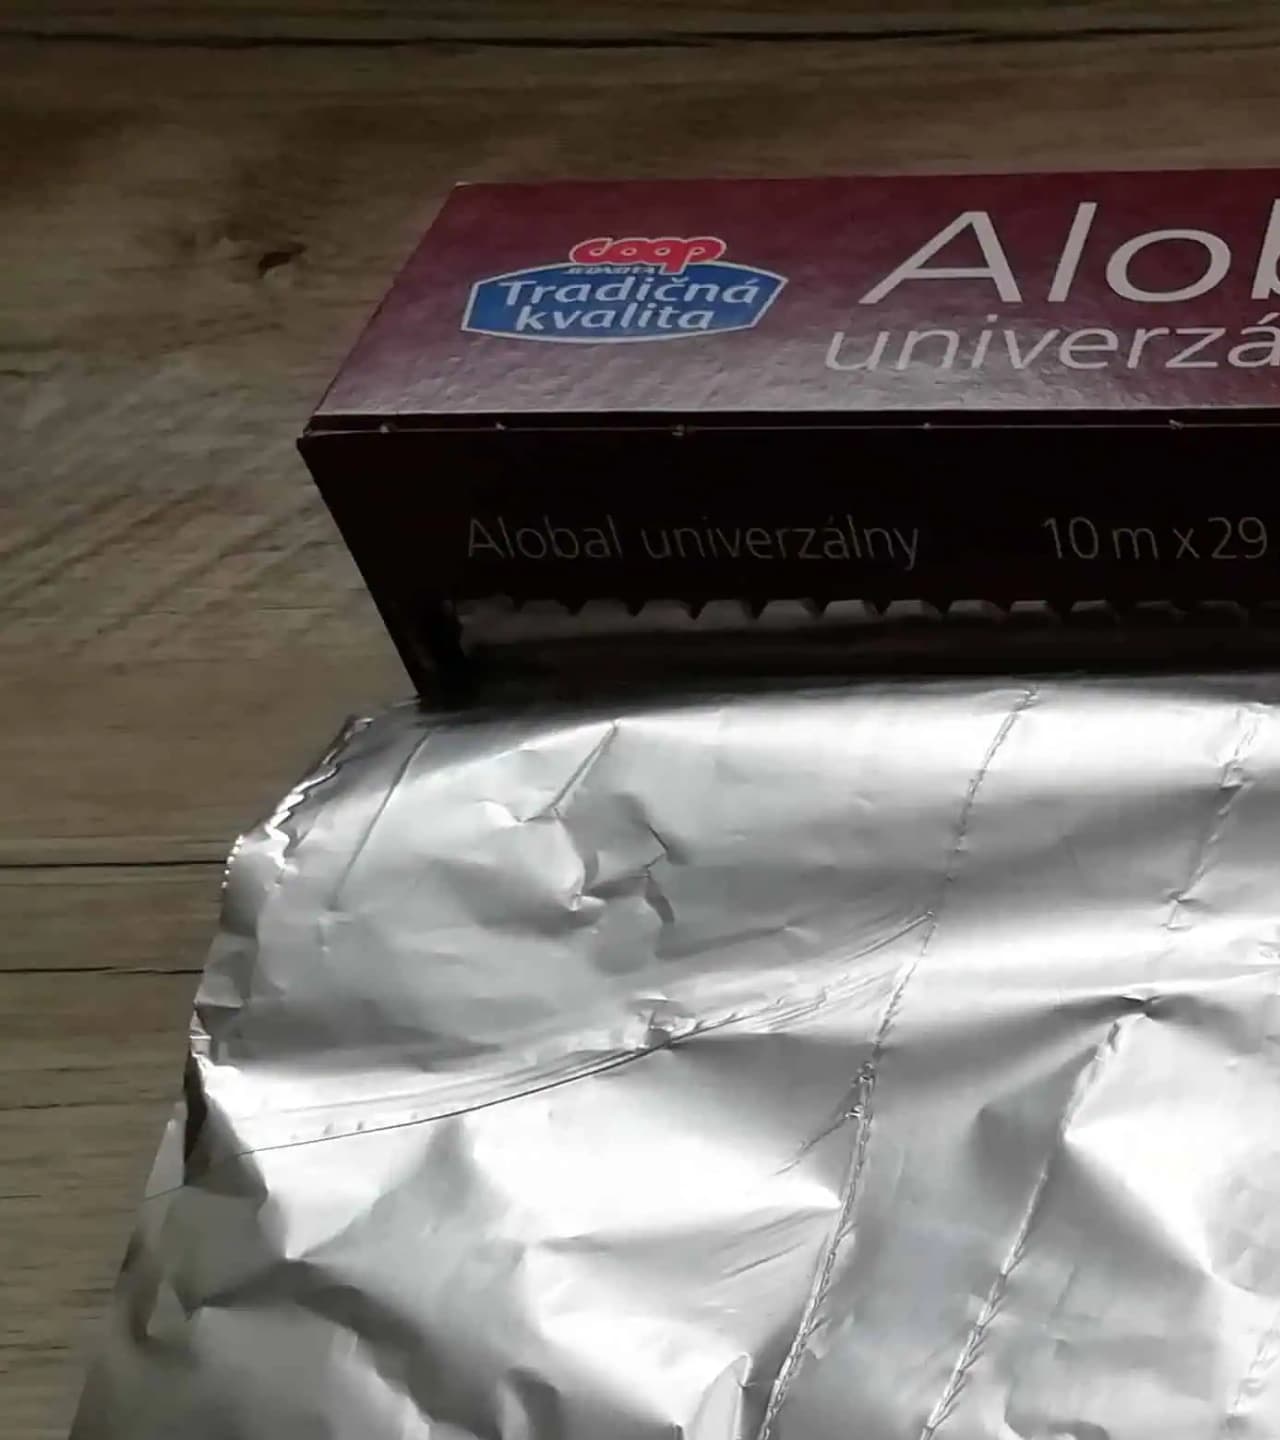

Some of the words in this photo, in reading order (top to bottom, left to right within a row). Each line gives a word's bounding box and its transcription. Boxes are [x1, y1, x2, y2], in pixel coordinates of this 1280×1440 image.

[499, 275, 761, 307] Tradičná
[515, 301, 716, 332] kvalita
[467, 514, 624, 560] Alobal
[640, 513, 919, 571] univerzálny
[1041, 516, 1099, 560] 10
[1111, 526, 1160, 560] m
[1172, 527, 1201, 560] x
[1207, 516, 1268, 560] 29
